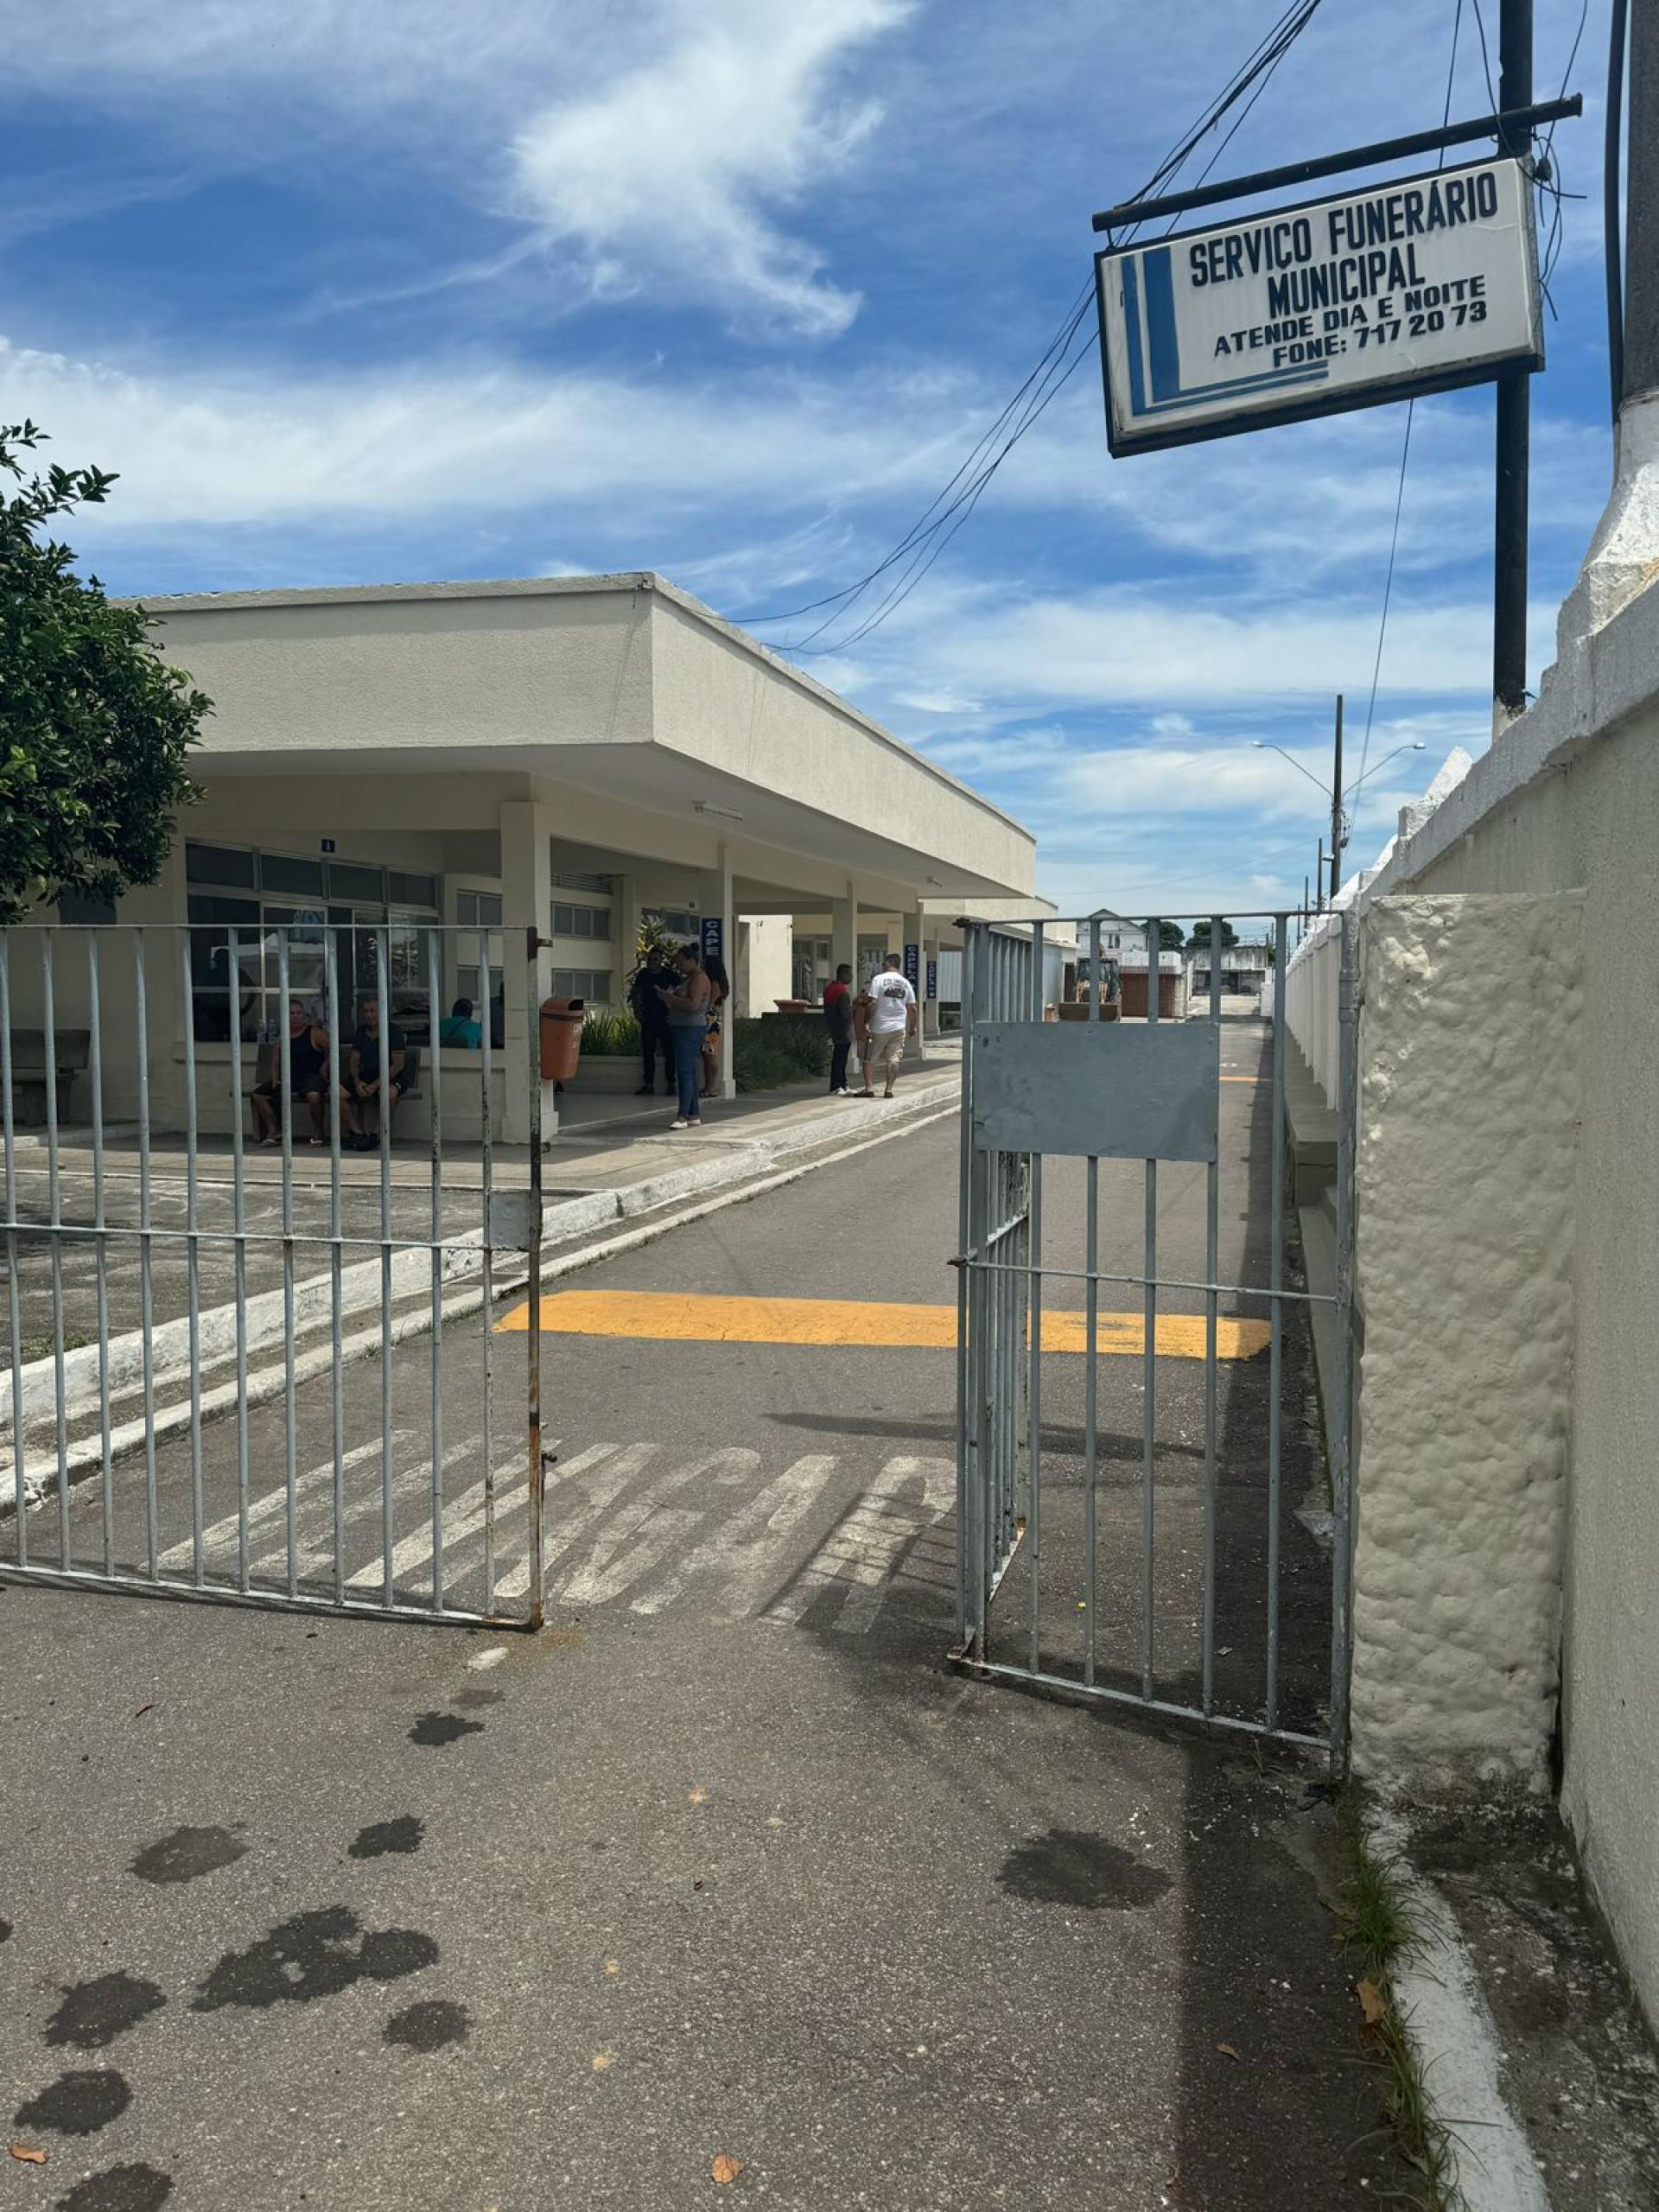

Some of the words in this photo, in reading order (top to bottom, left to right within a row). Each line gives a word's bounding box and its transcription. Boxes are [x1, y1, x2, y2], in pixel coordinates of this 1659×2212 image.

[1328, 172, 1498, 255] FUNERÁRIO
[1214, 315, 1313, 358] ATENDE
[1323, 304, 1368, 333] DIA
[1378, 296, 1394, 319] E
[1405, 275, 1485, 313] NOITE
[1268, 243, 1426, 320] MUNICIPAL
[1273, 334, 1347, 367] FONE:
[1354, 319, 1402, 349] 717
[1408, 309, 1445, 337] 20
[1451, 301, 1487, 326] 73
